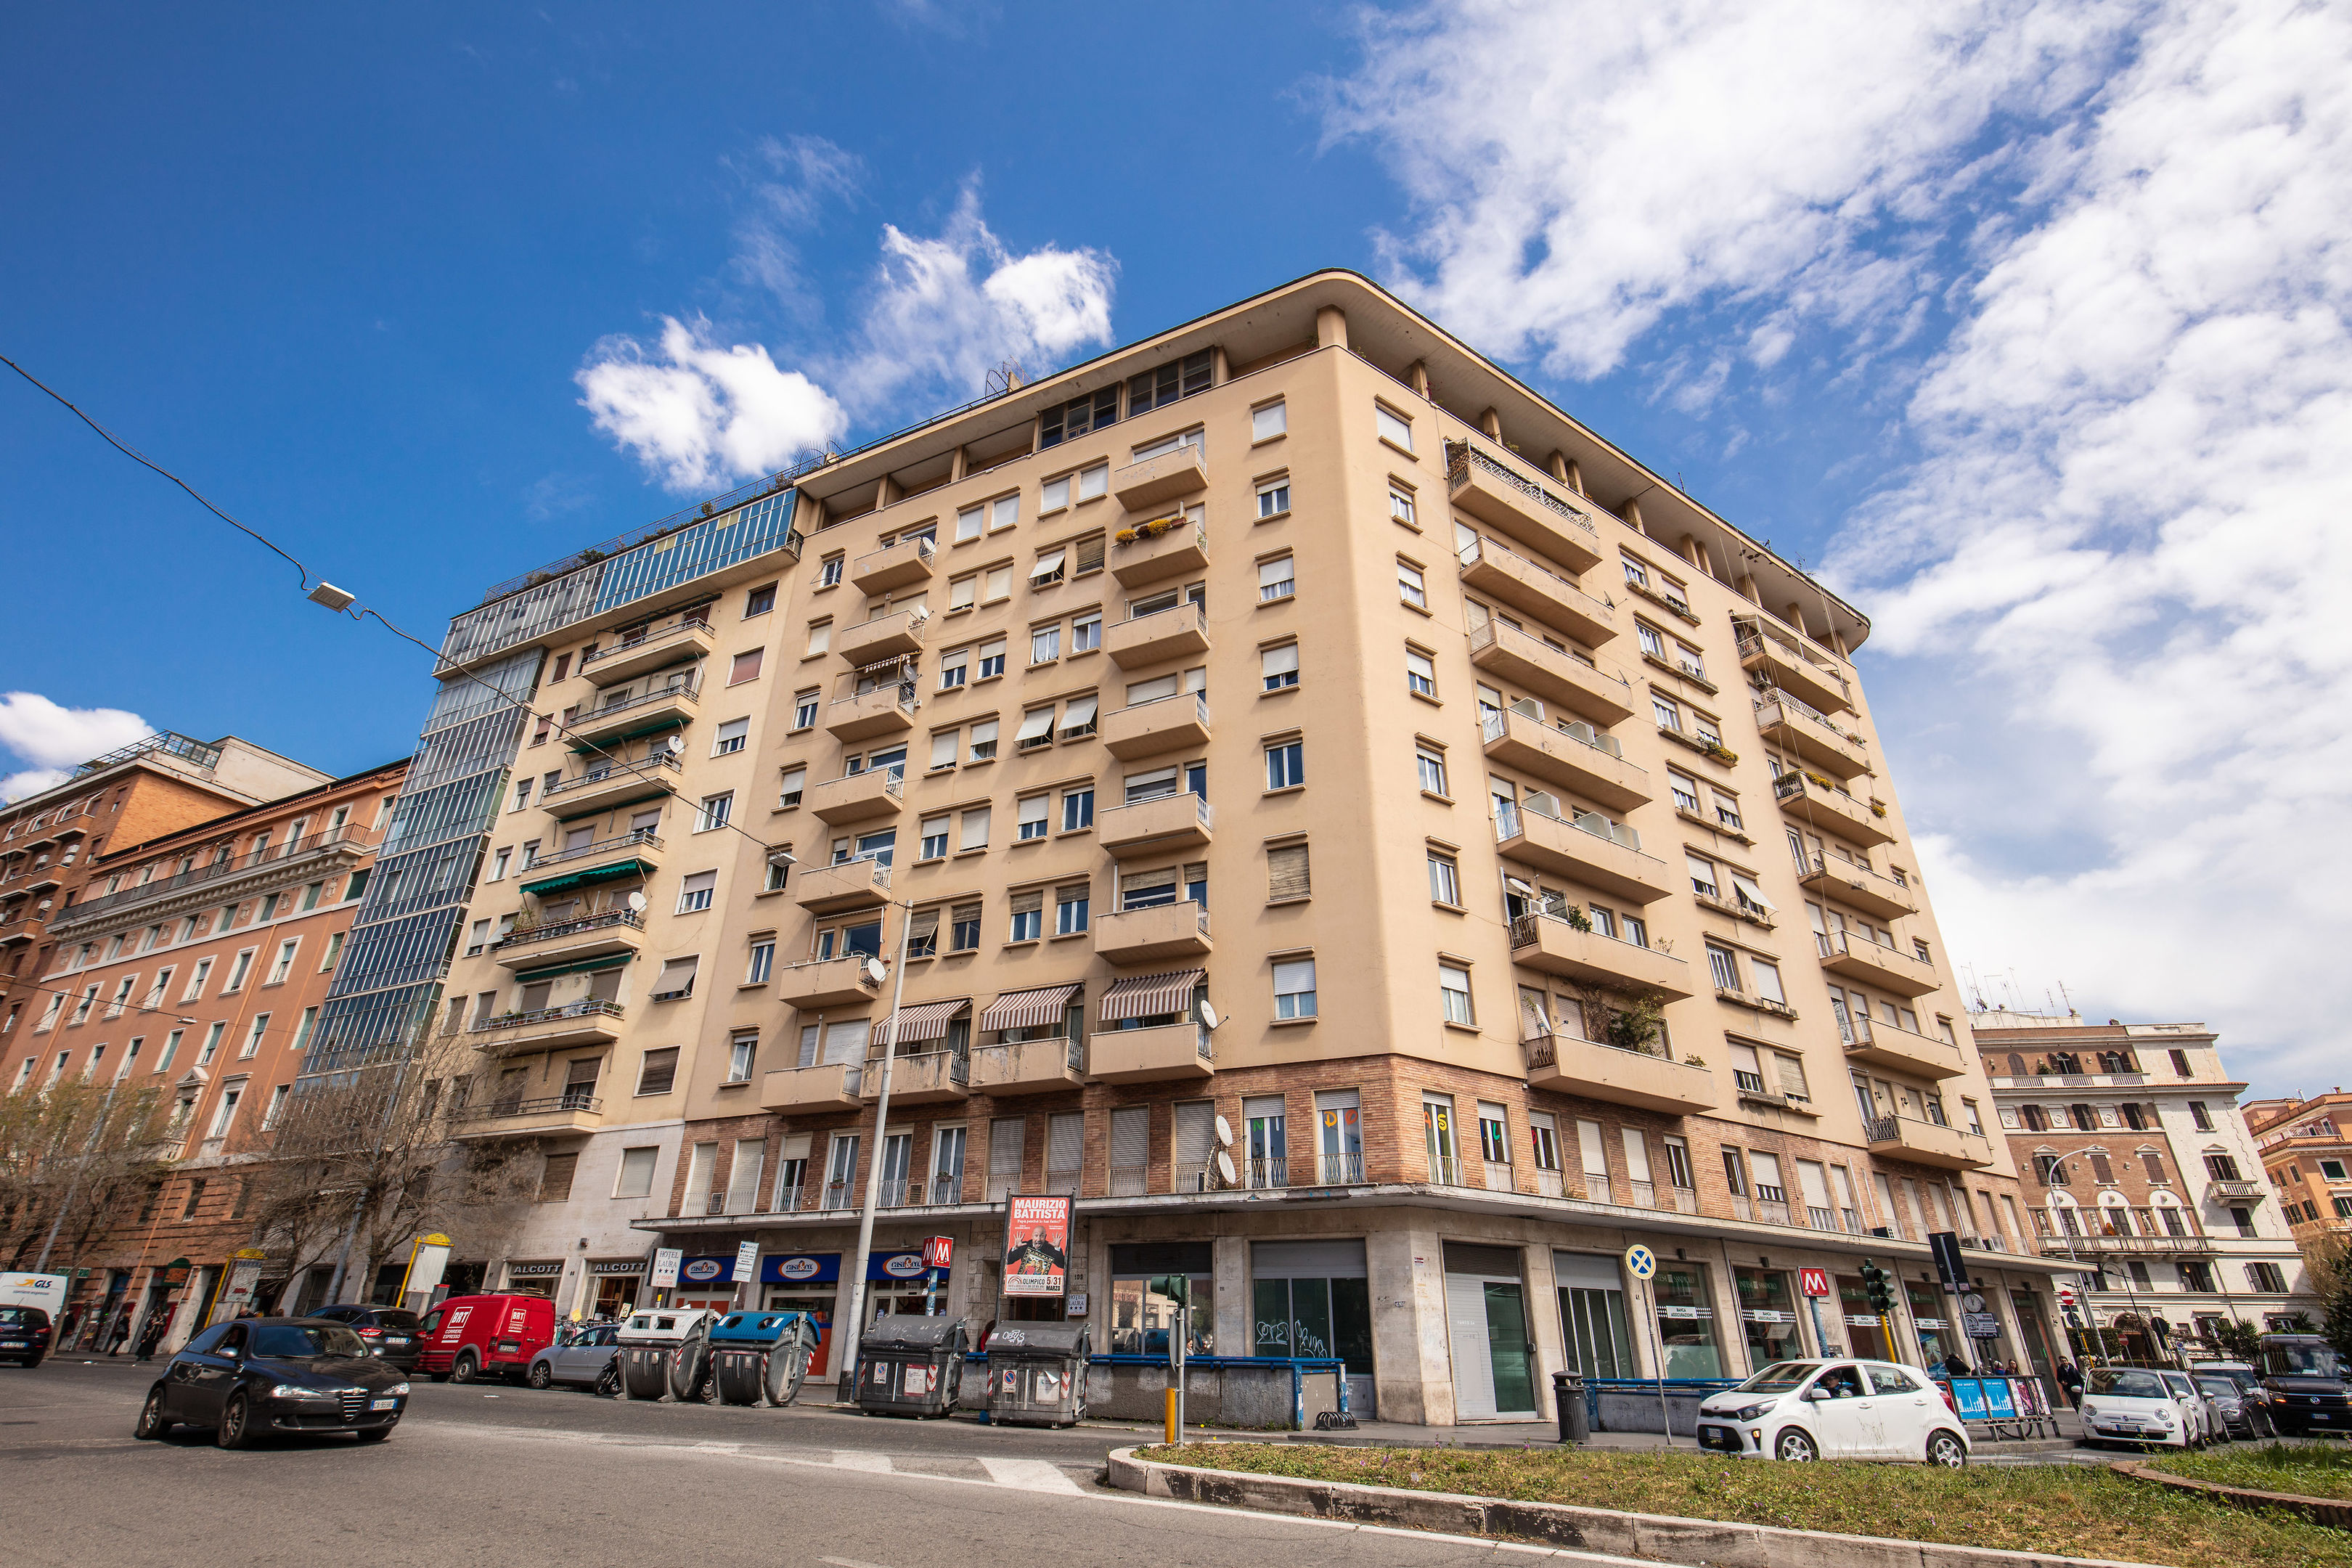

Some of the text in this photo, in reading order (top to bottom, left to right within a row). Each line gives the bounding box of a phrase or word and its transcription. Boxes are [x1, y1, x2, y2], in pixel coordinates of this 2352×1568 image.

[1015, 1199, 1066, 1209] MAURIZIO
[1013, 1209, 1066, 1219] BATTISTA
[659, 1250, 679, 1259] HOTEL
[923, 1242, 933, 1262] M
[935, 1242, 950, 1262] M
[514, 1265, 561, 1273] ALCOTT
[595, 1262, 646, 1271] ALCOTT
[1046, 1276, 1061, 1285] 5/31
[1805, 1273, 1826, 1291] M
[451, 1311, 469, 1323] BRT
[512, 1312, 526, 1320] BRT
